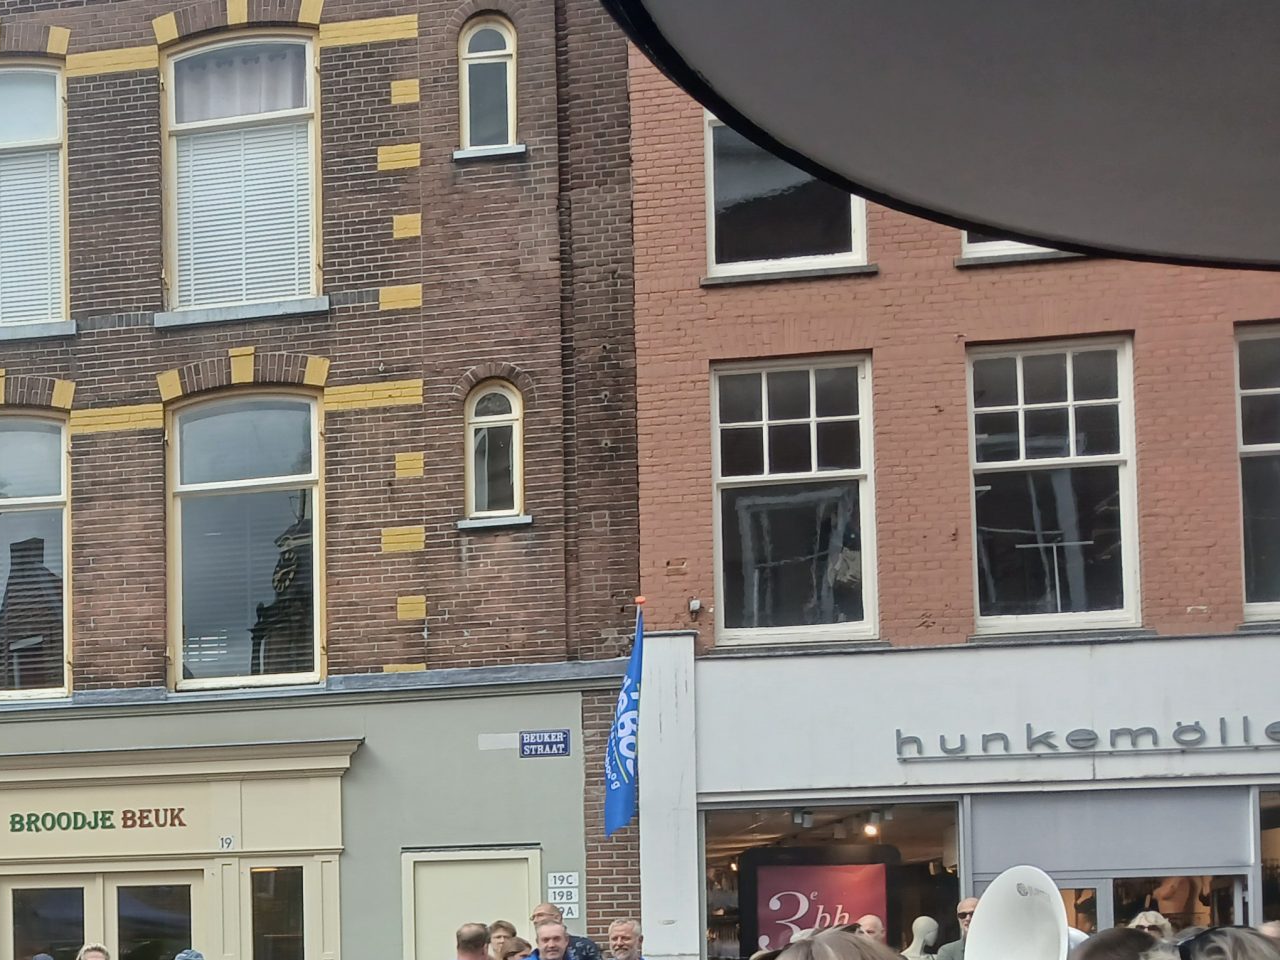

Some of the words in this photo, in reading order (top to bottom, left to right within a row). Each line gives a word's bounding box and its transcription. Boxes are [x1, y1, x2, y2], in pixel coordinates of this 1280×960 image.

[523, 732, 566, 743] BEUKER-
[9, 810, 117, 833] BROODJE
[121, 807, 188, 829] BEUK
[220, 837, 233, 849] 19
[552, 874, 574, 886] 19C
[552, 890, 573, 901] 19B
[559, 906, 574, 916] 9A
